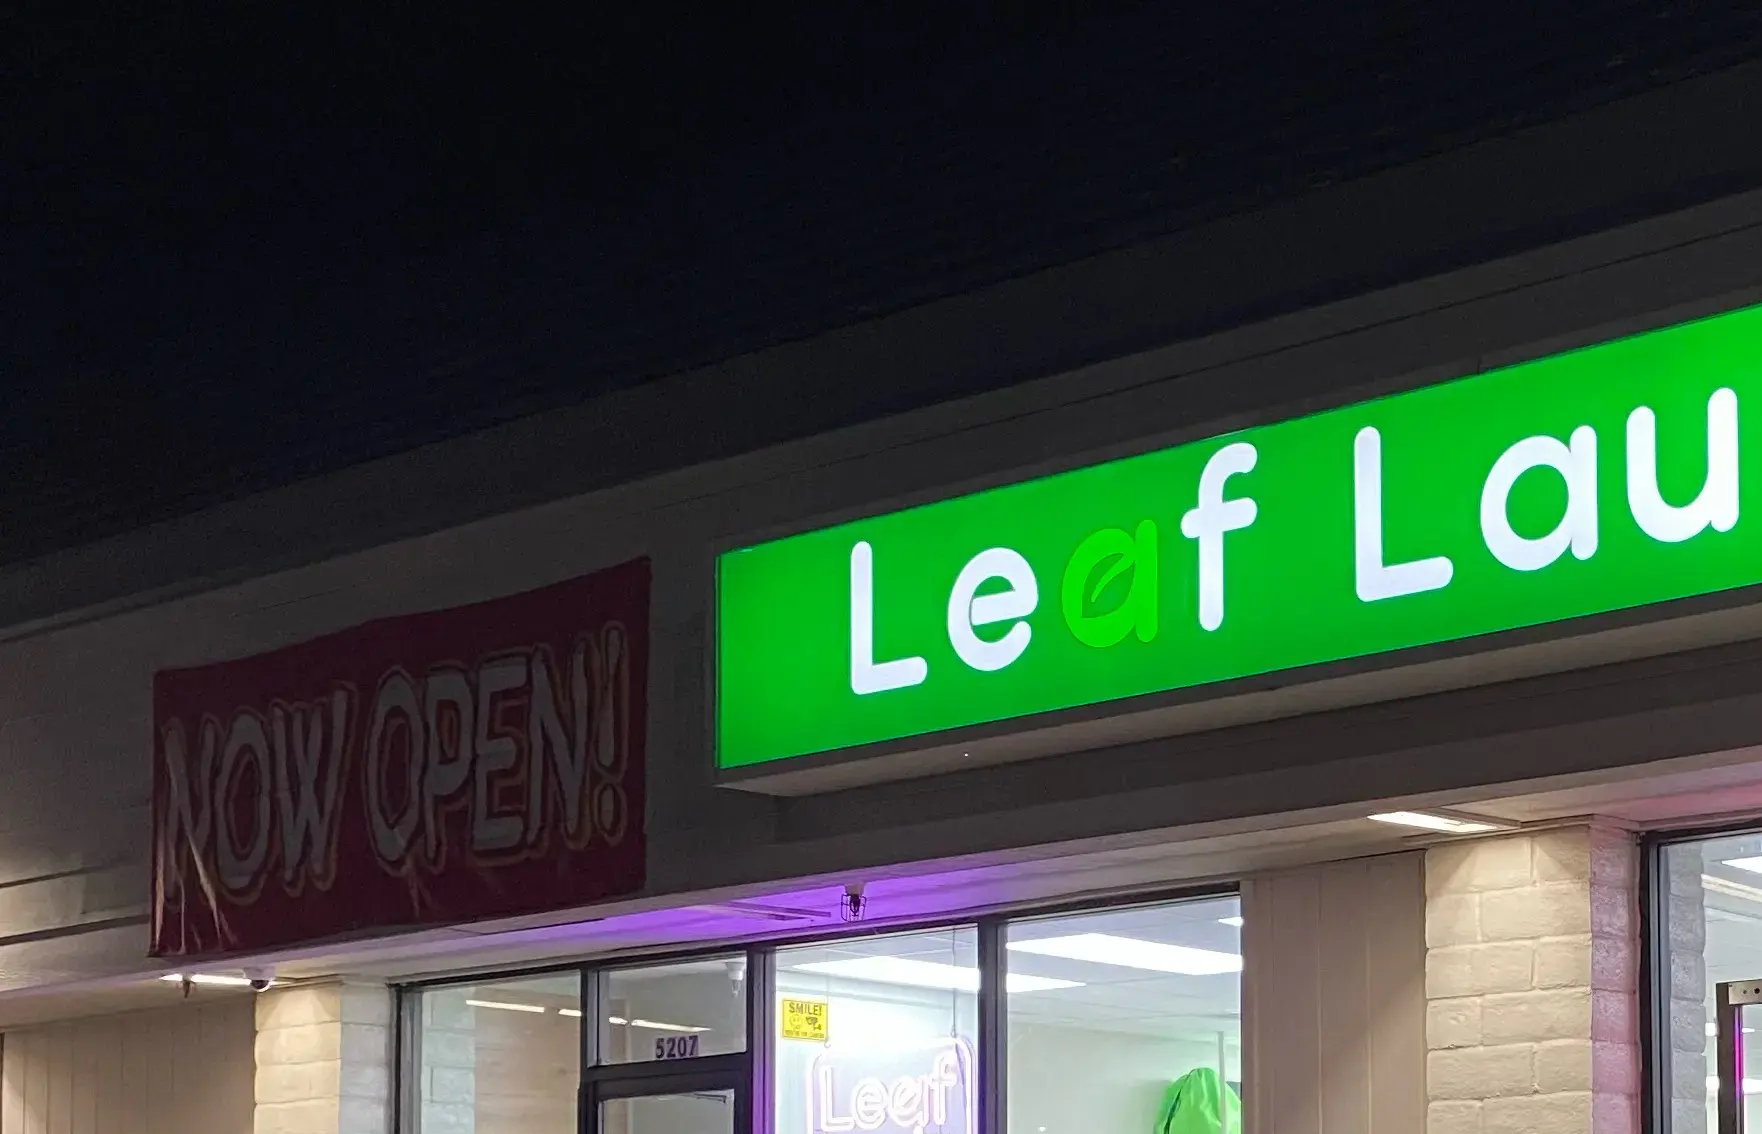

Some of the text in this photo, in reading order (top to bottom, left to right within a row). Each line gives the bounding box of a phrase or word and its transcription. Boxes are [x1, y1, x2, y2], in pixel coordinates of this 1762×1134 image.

[850, 443, 1258, 695] Leaf
[163, 620, 628, 903] NOW OPEN!
[655, 1034, 699, 1060] 5207
[788, 1002, 823, 1017] SMILE!
